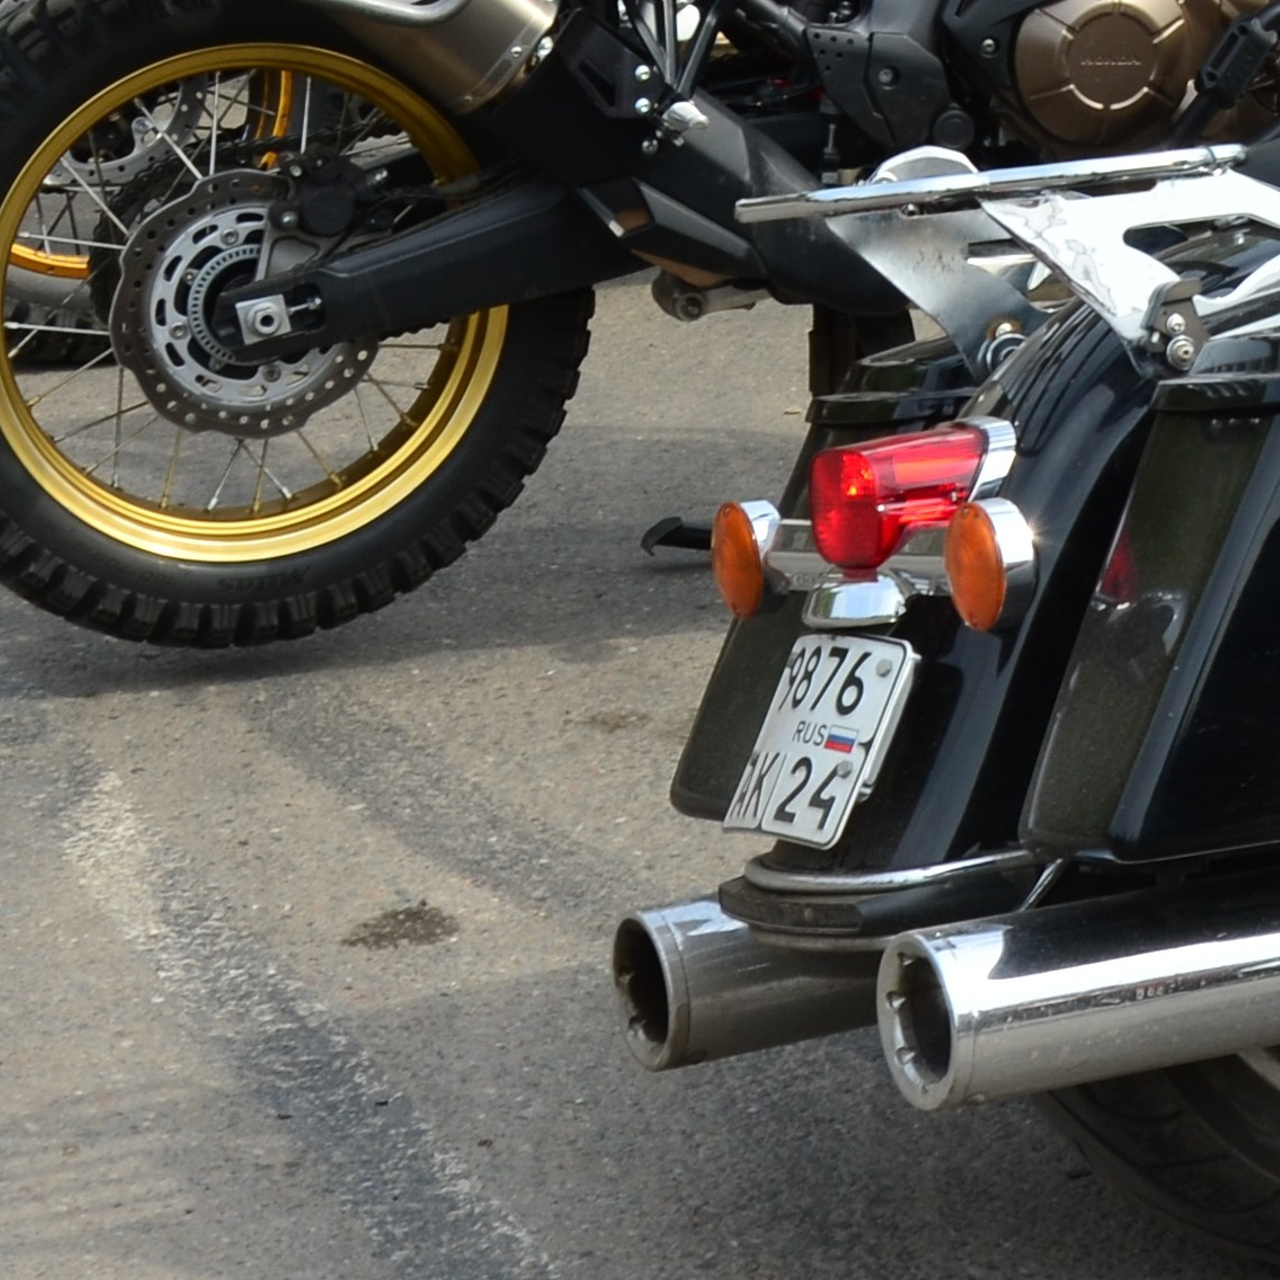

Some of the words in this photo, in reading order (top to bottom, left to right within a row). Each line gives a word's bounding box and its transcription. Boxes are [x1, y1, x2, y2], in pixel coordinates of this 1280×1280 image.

[778, 645, 872, 717] 9876
[792, 720, 828, 747] RUS
[773, 756, 848, 831] 24
